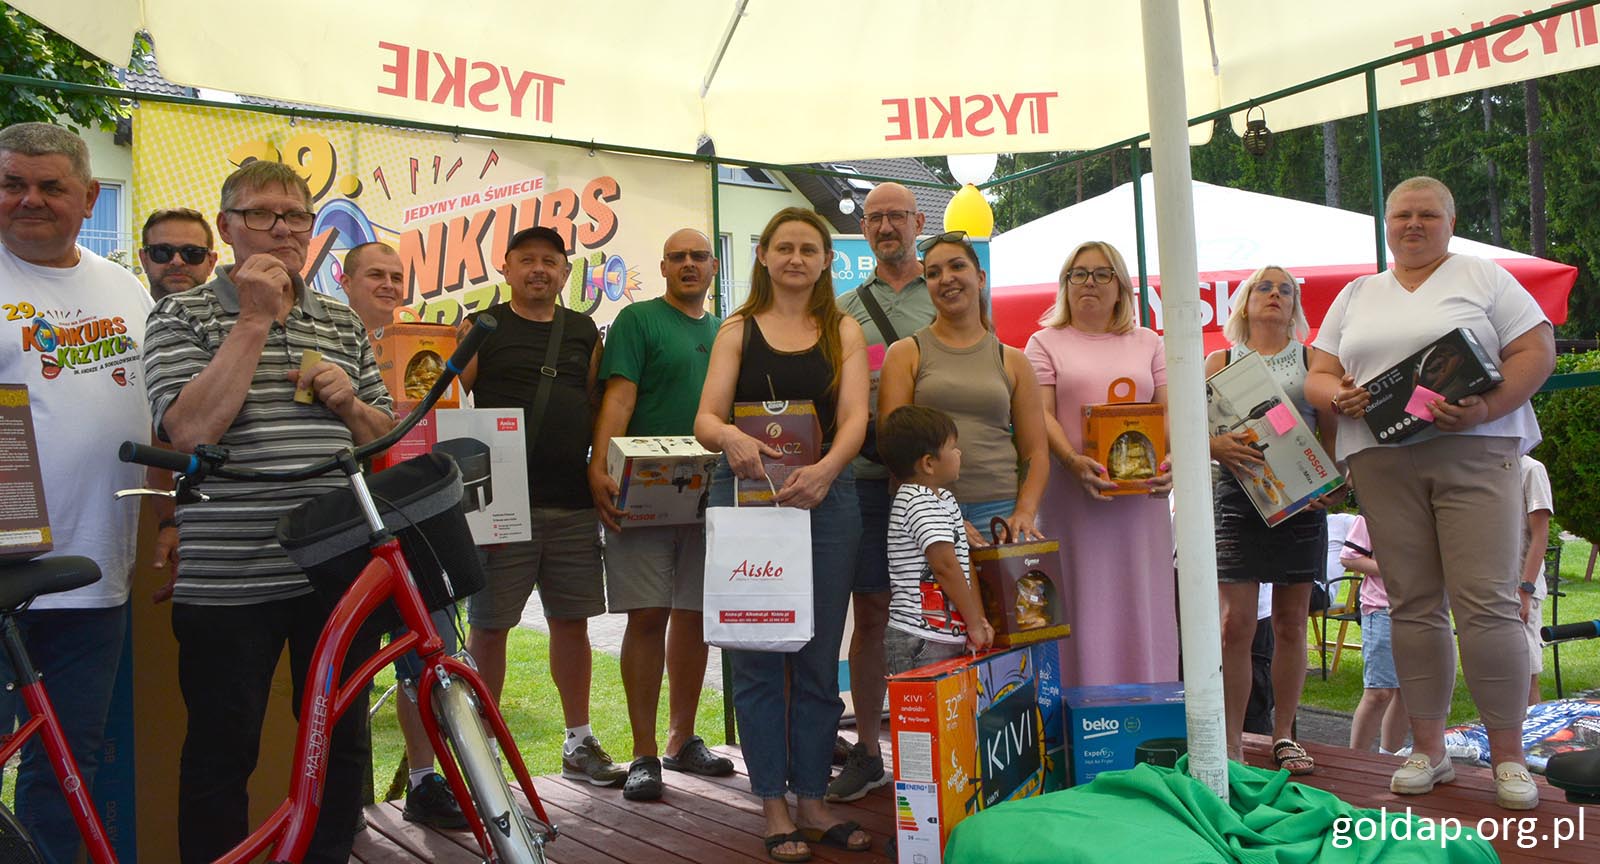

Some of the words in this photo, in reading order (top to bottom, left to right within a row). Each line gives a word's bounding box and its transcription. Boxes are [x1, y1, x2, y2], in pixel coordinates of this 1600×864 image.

[404, 198, 457, 224] JEDYNY
[460, 193, 480, 207] NA
[484, 177, 543, 202] ŚWIECIE
[2, 302, 45, 321] 29.
[57, 335, 128, 369] KRZYKU
[1303, 447, 1328, 479] BOSCH
[729, 560, 783, 581] Aisko
[1082, 717, 1119, 731] beko
[987, 709, 1033, 781] KIVI
